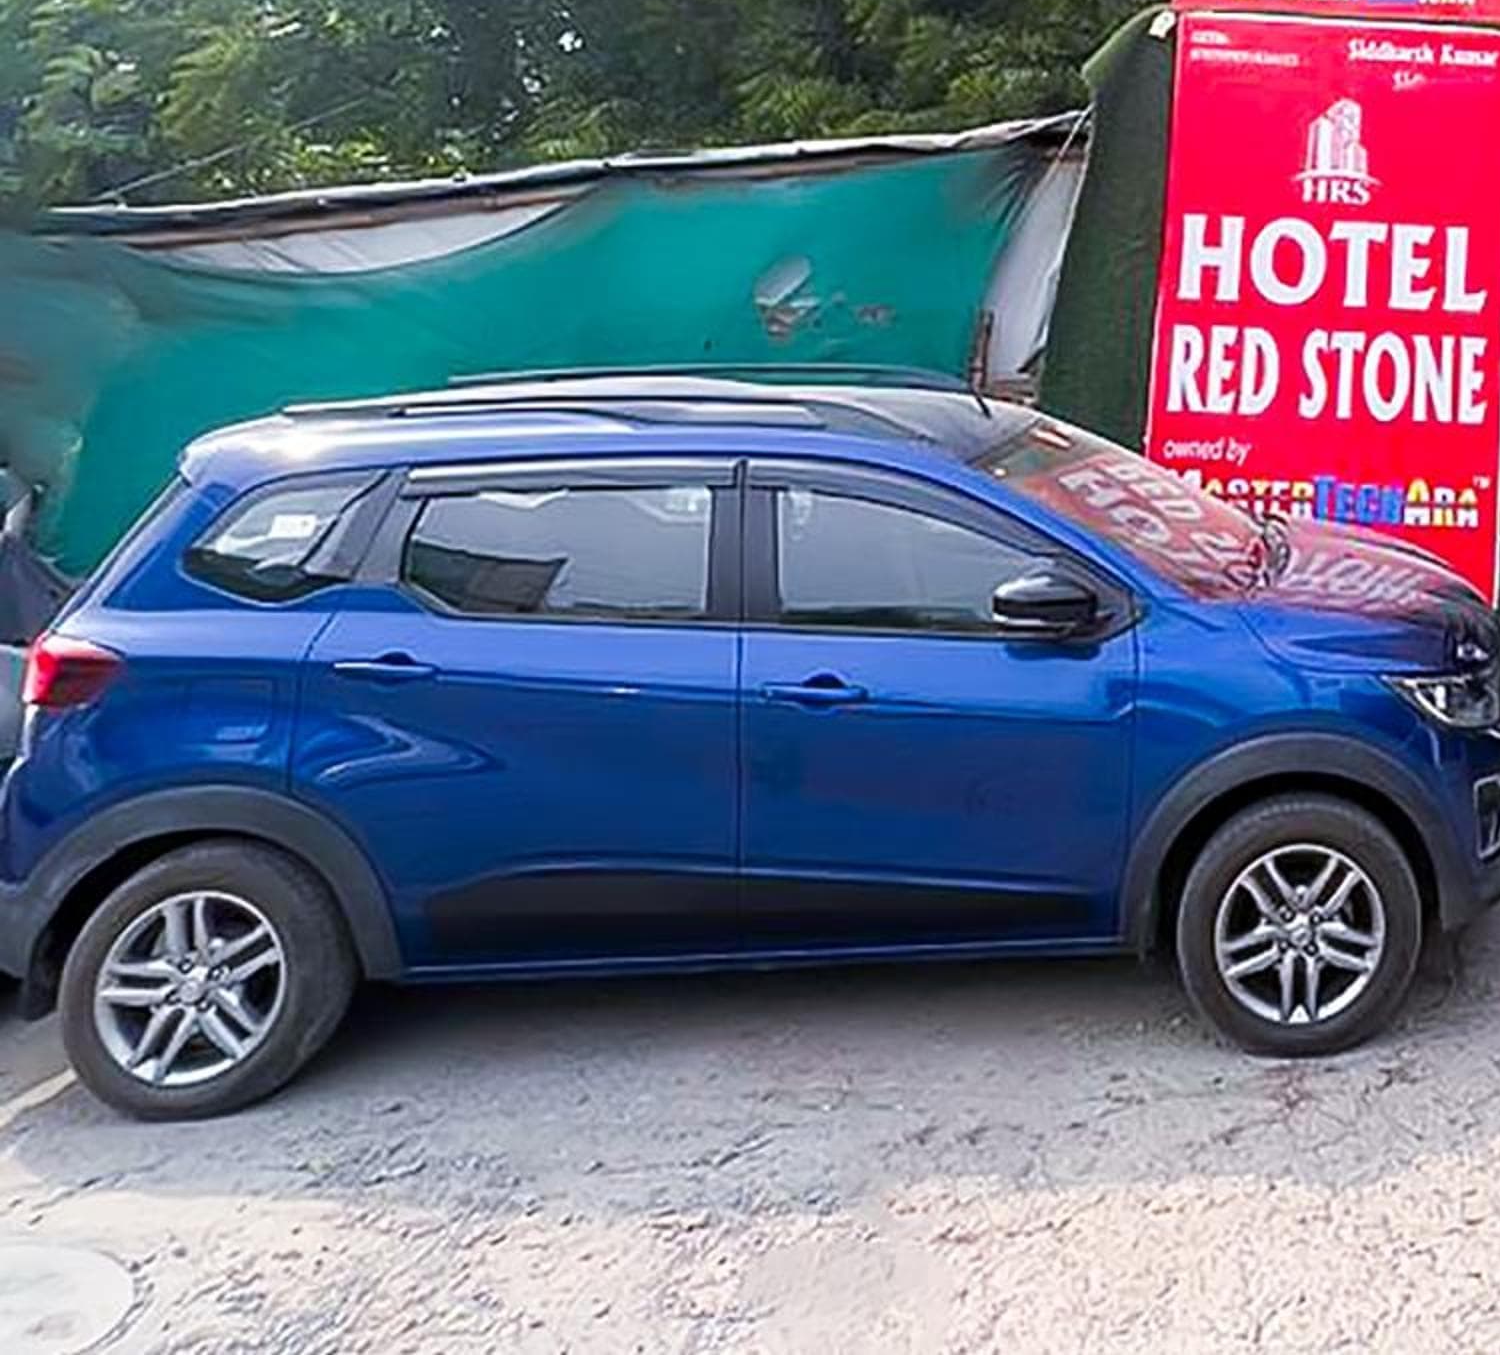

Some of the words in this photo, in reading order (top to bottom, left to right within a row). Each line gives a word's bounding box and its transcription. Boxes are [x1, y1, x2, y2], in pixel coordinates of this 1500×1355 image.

[1302, 178, 1371, 205] HRS
[1177, 213, 1487, 313] HOTEL
[1166, 324, 1280, 416] RED
[1299, 328, 1487, 424] STONE
[1162, 438, 1223, 461] owned
[1226, 438, 1251, 466] by
